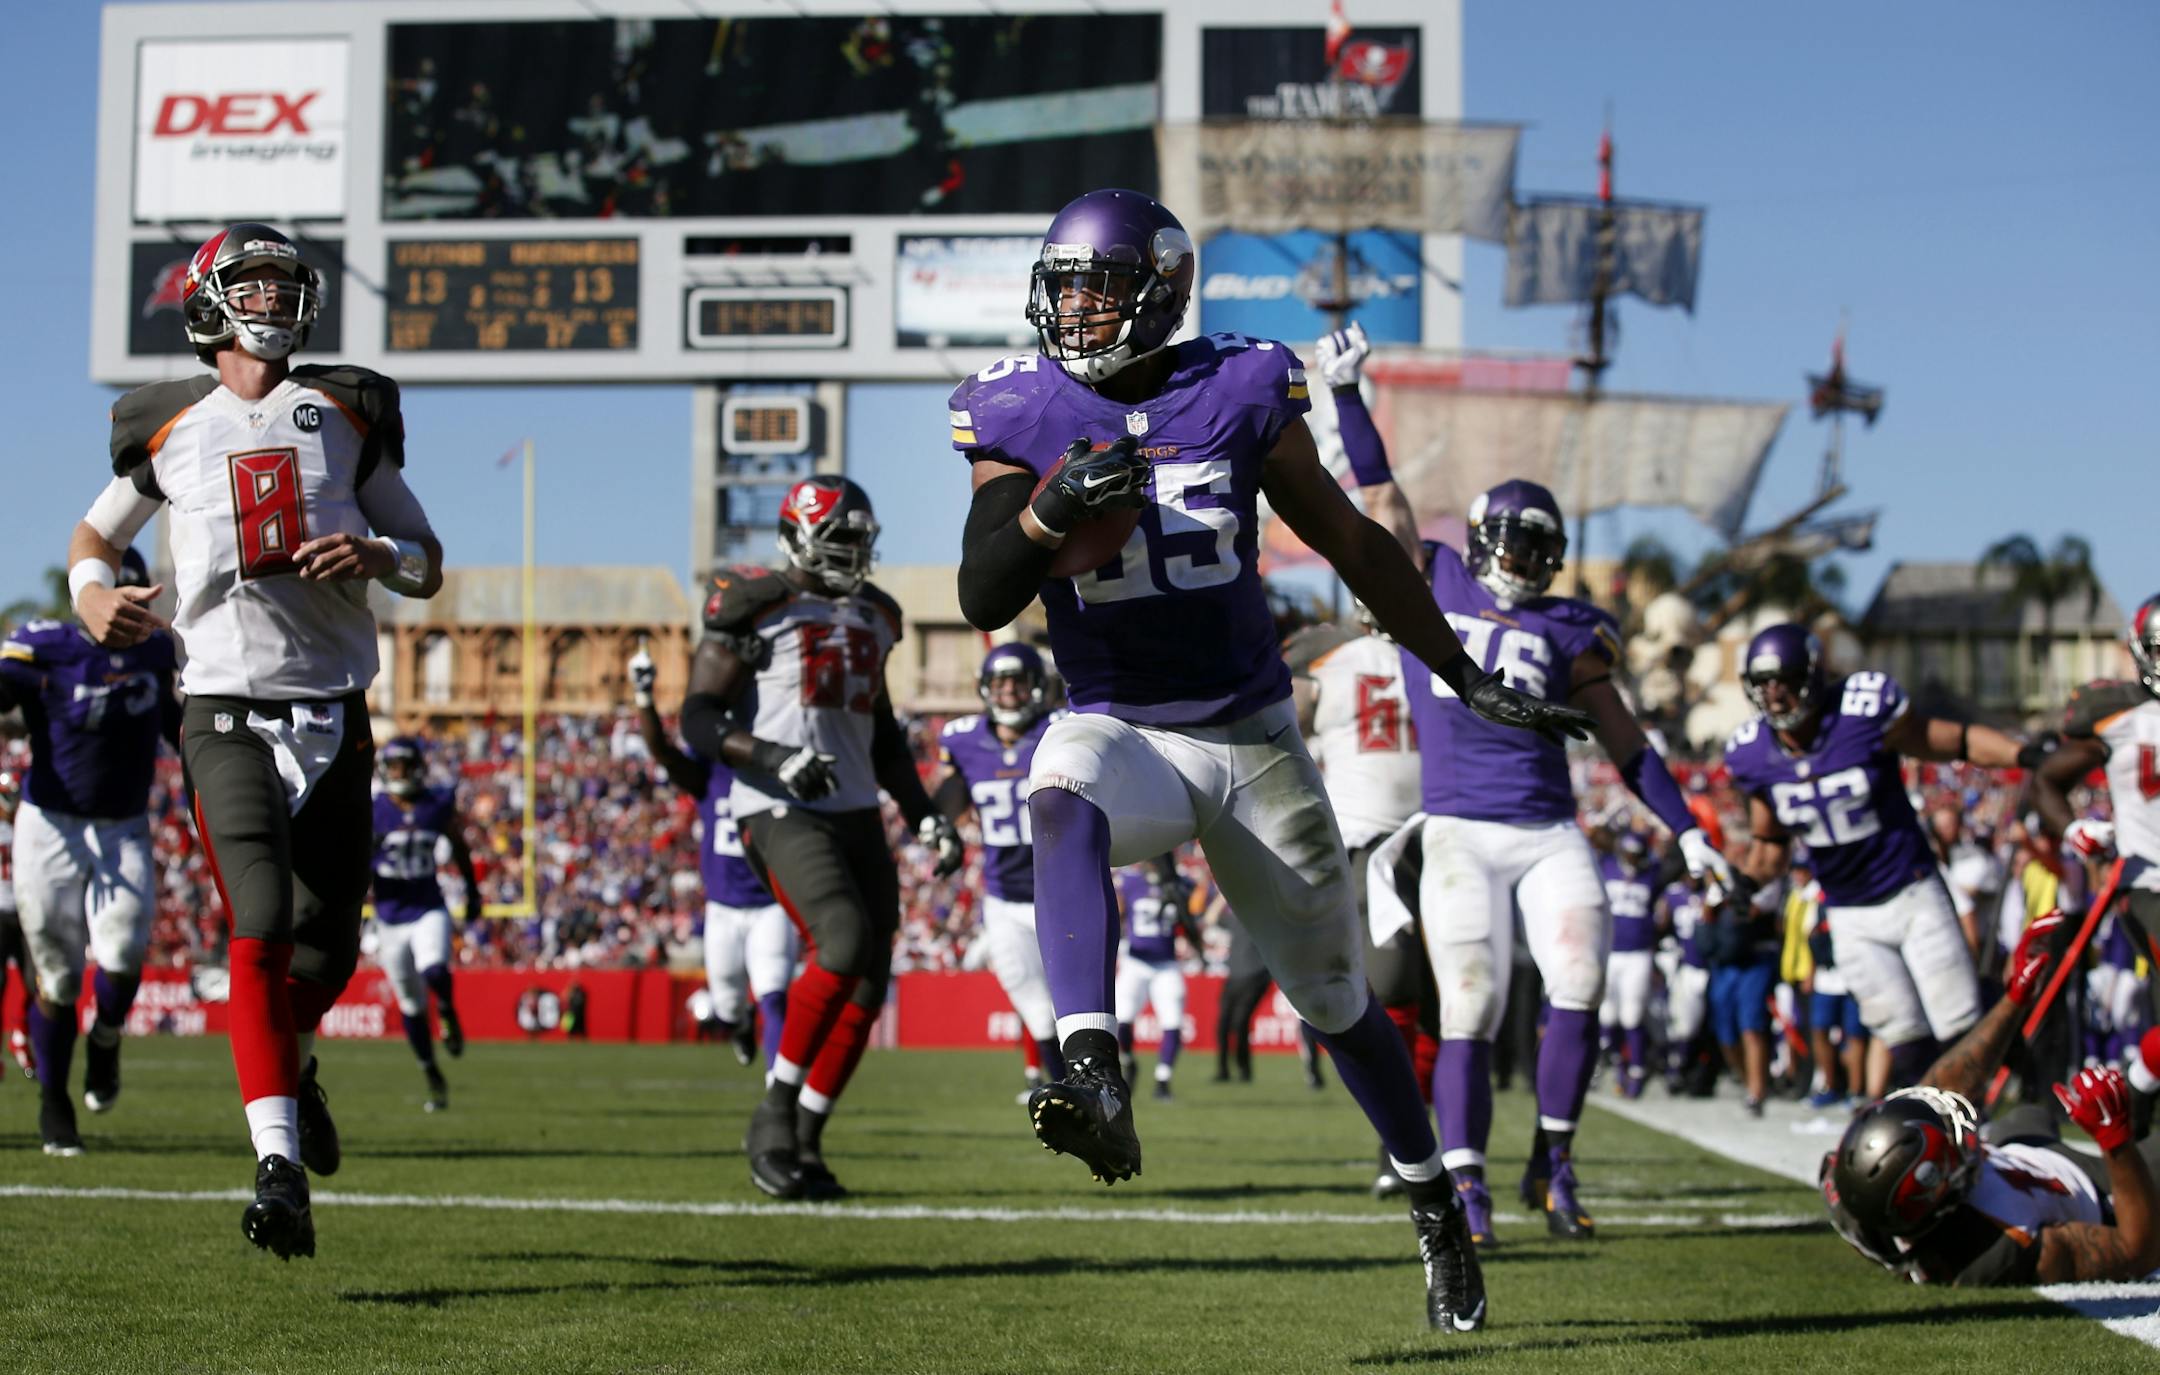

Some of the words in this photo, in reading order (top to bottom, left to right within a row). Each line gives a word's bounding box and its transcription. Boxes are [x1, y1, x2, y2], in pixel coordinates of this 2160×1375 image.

[153, 91, 320, 137] DEX
[190, 139, 339, 164] imaging
[405, 269, 449, 304] 13
[572, 266, 614, 304] 13
[296, 408, 319, 426] MG
[226, 446, 309, 580] 8
[803, 623, 880, 713] 69
[1358, 675, 1420, 754] 6
[1840, 671, 1887, 717] 52
[1771, 766, 1882, 848] 52
